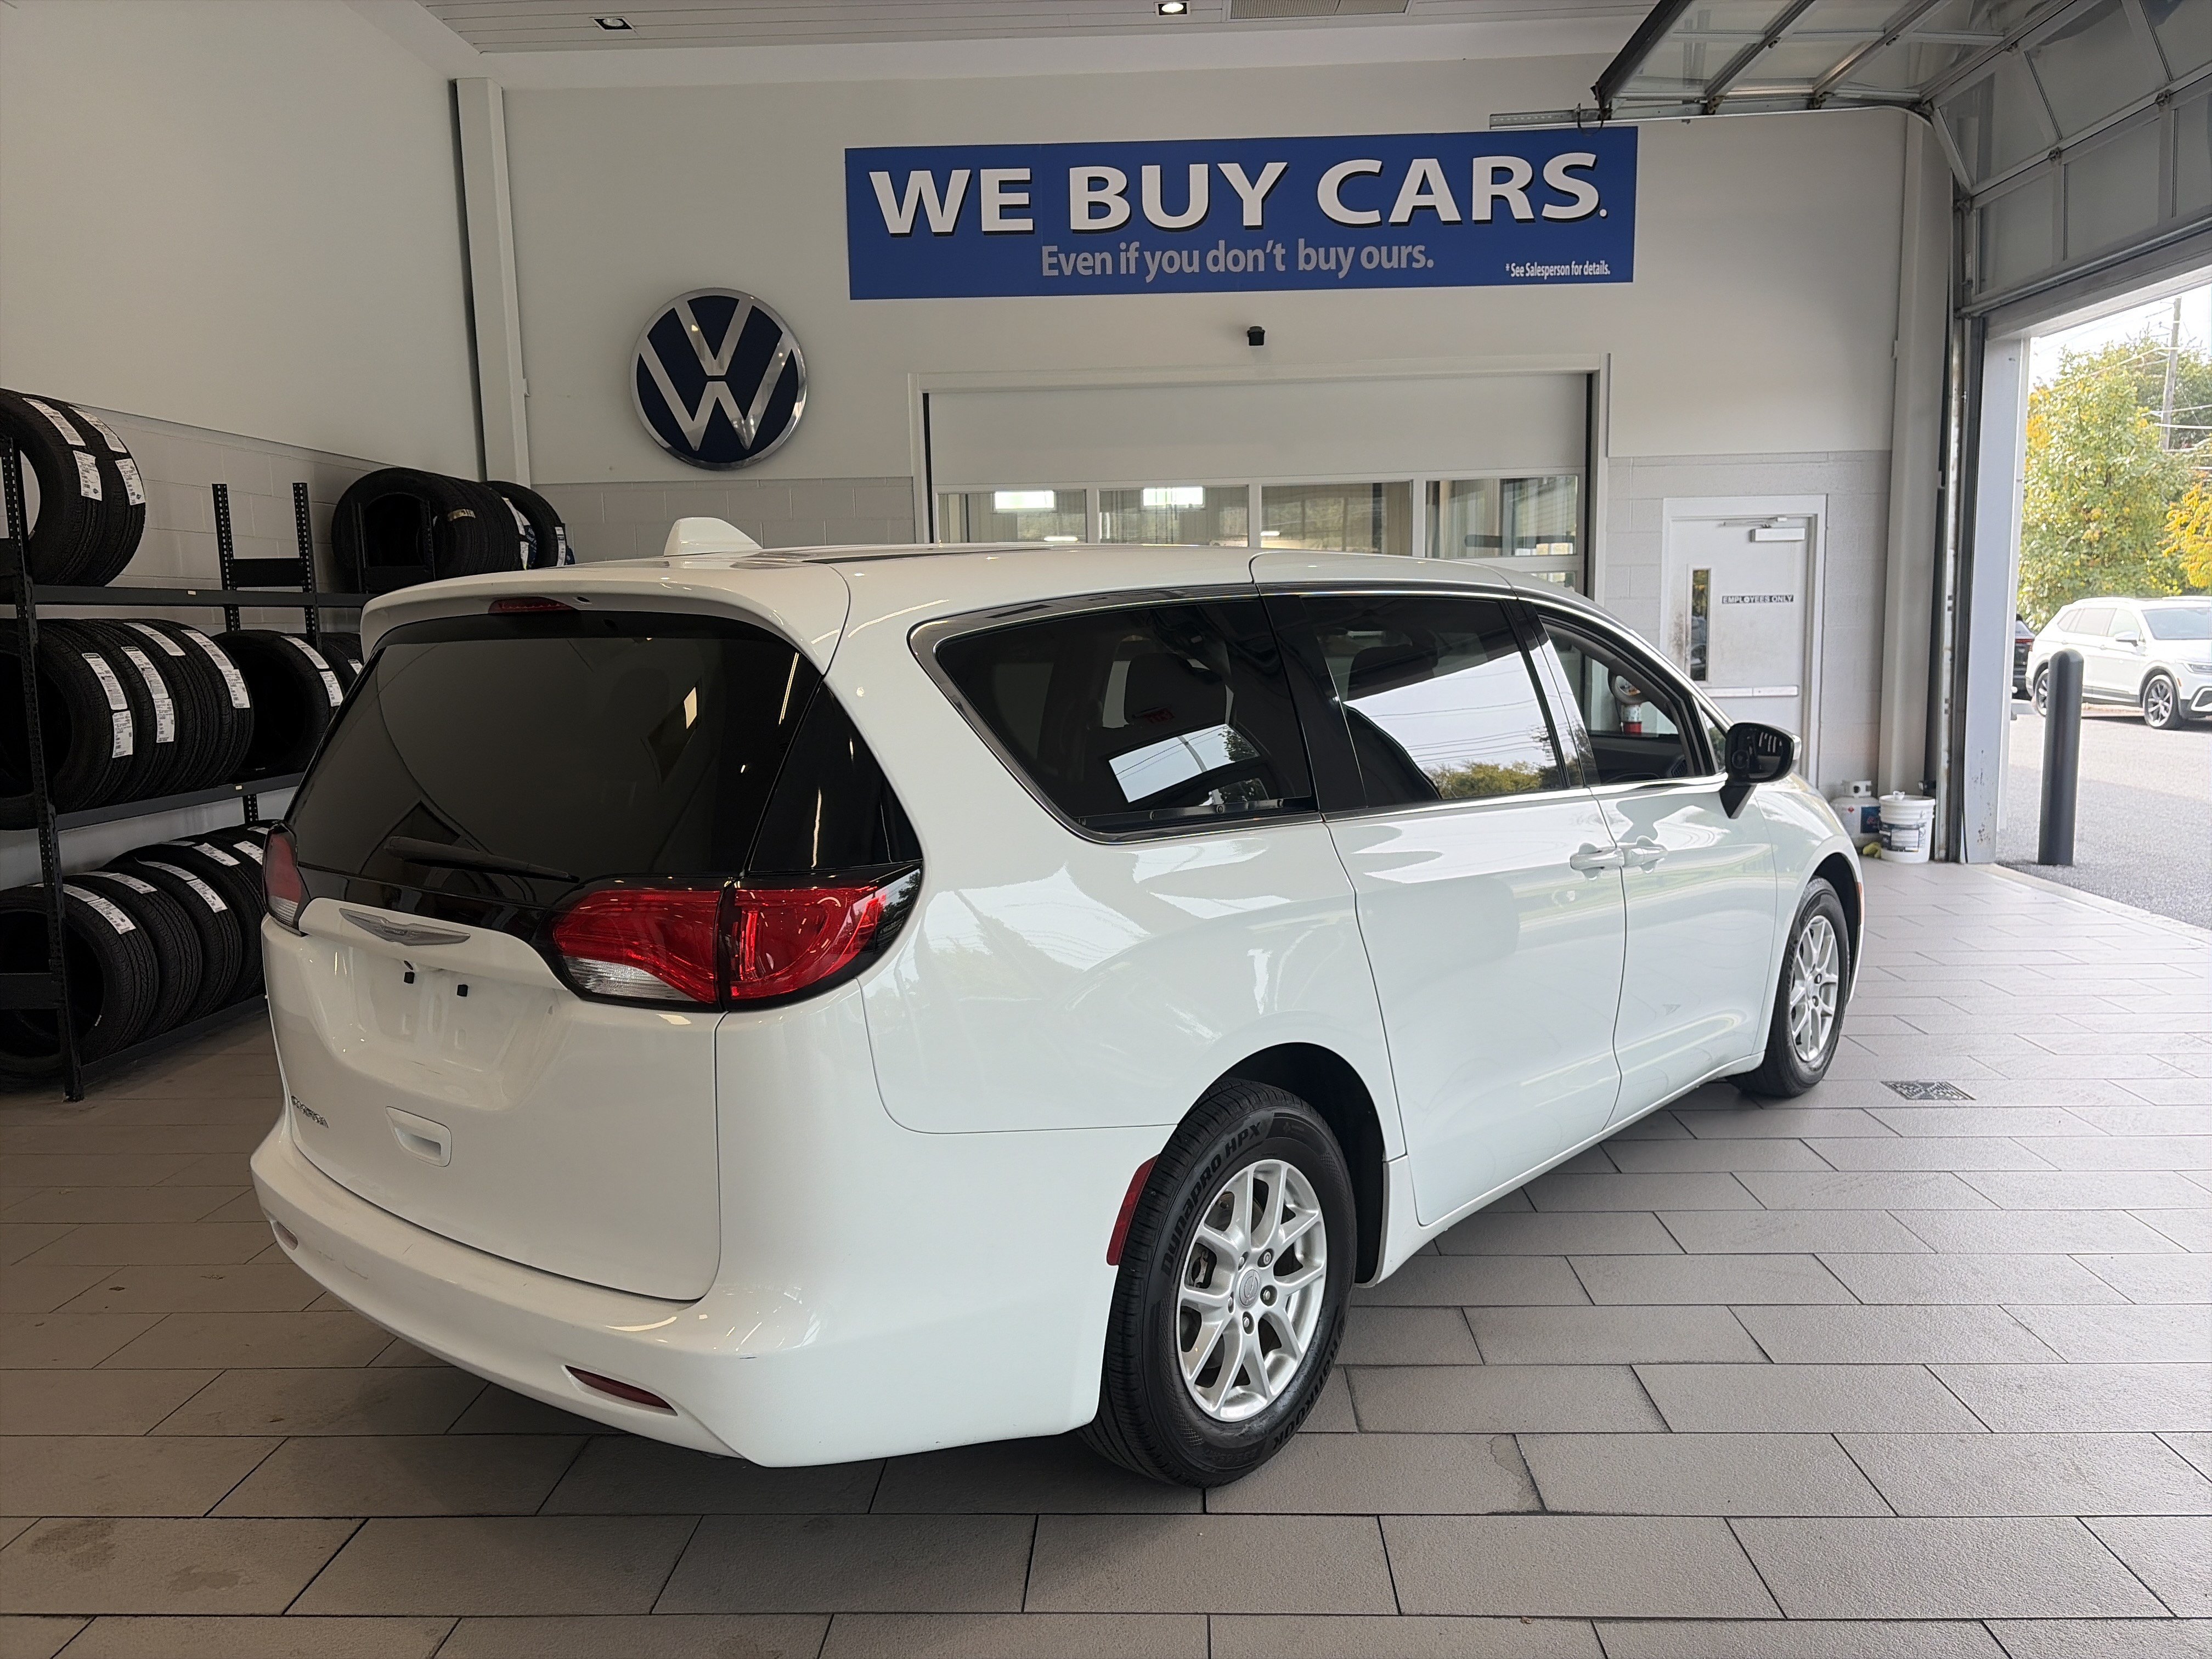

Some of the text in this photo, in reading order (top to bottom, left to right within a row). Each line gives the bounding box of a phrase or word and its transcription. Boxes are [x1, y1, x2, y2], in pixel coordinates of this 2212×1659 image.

[869, 153, 1607, 235] WE BUY CARS.
[1042, 238, 1434, 284] Even if you don't buy ours.
[1525, 261, 1570, 280] Salesperson
[1571, 260, 1583, 275] for
[1583, 259, 1611, 275] details.
[1723, 594, 1793, 603] EMPLOYEES ONLY
[1224, 1122, 1261, 1159] HPX
